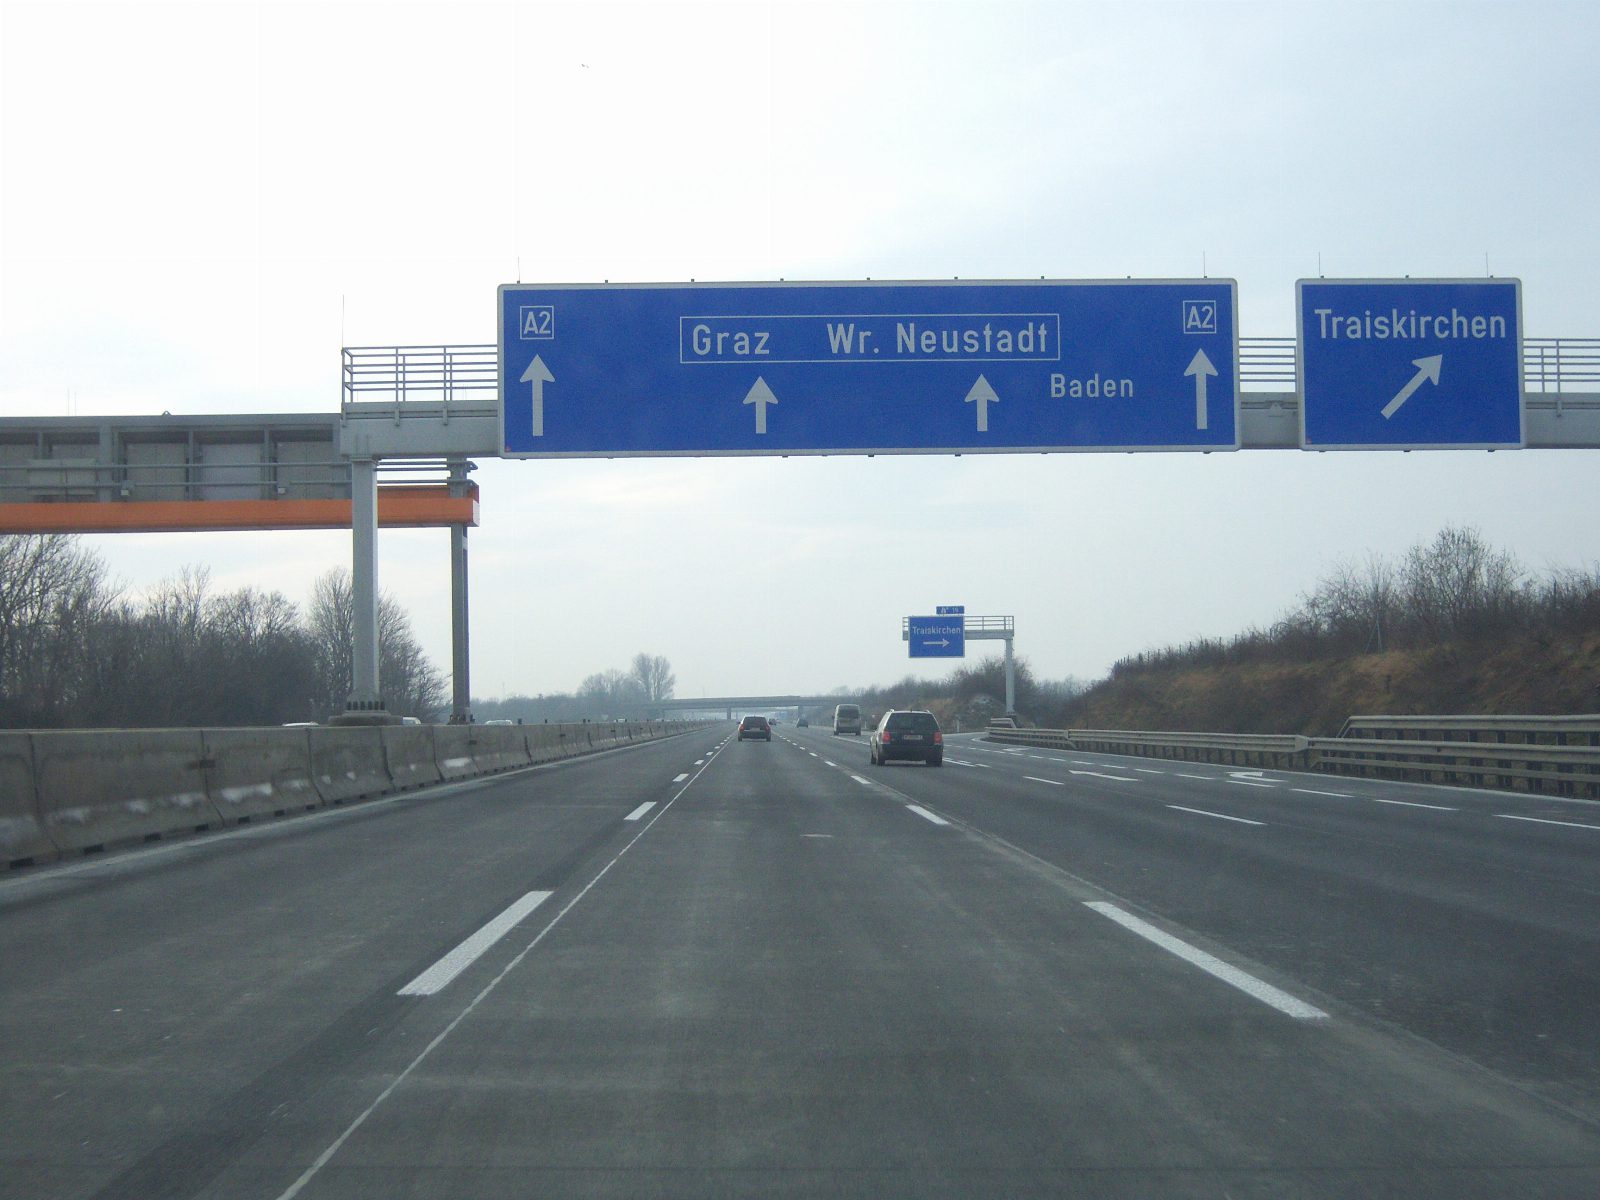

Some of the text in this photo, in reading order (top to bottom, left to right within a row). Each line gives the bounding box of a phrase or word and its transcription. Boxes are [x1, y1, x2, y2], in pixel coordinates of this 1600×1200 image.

[523, 311, 552, 335] A2
[1187, 305, 1214, 329] A2
[1314, 308, 1506, 339] Traiskirchen
[692, 322, 1048, 355] Graz Wr. Neustadt
[1050, 373, 1134, 398] Baden
[912, 626, 961, 635] Traiskirchen
